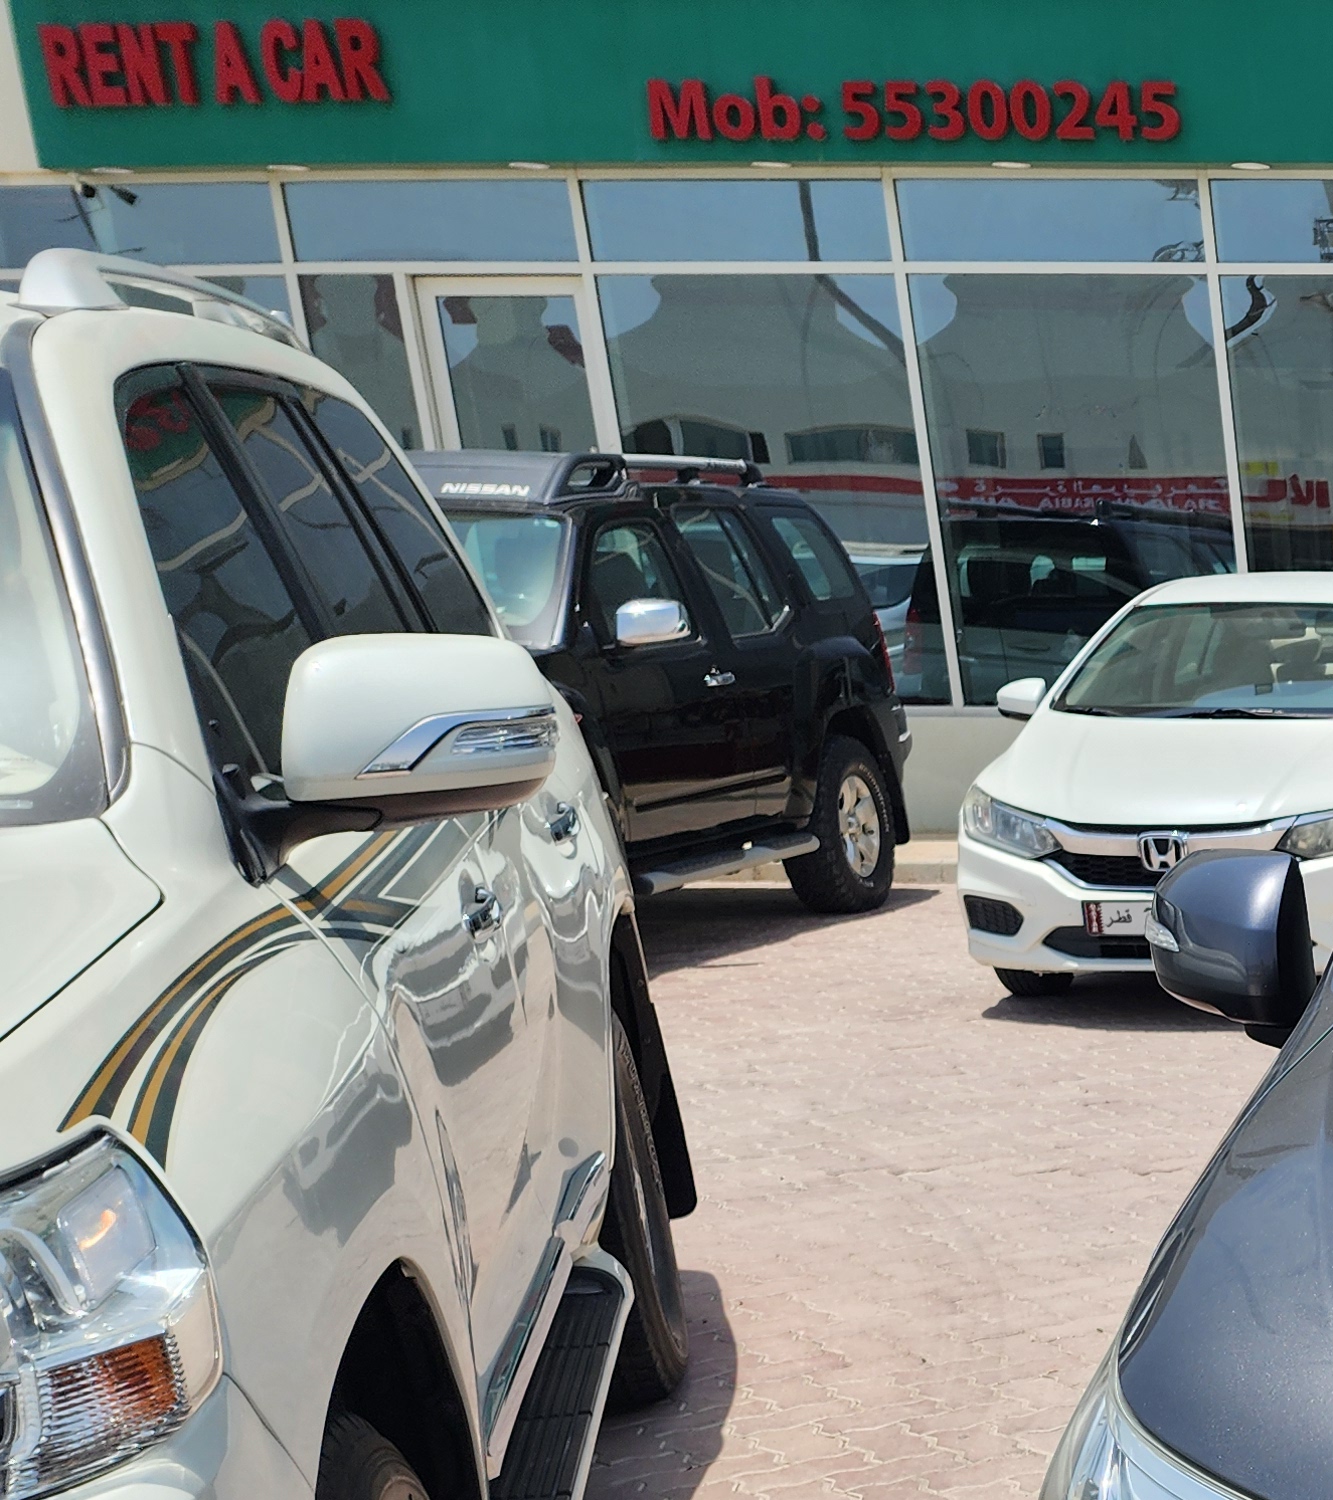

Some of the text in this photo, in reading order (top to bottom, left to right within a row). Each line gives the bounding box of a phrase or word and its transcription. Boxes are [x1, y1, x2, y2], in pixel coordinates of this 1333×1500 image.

[38, 17, 391, 108] RENT A CAR
[646, 75, 1181, 141] Mob: 55300245
[441, 482, 530, 497] NISSAN
[1105, 908, 1133, 928] قطر
